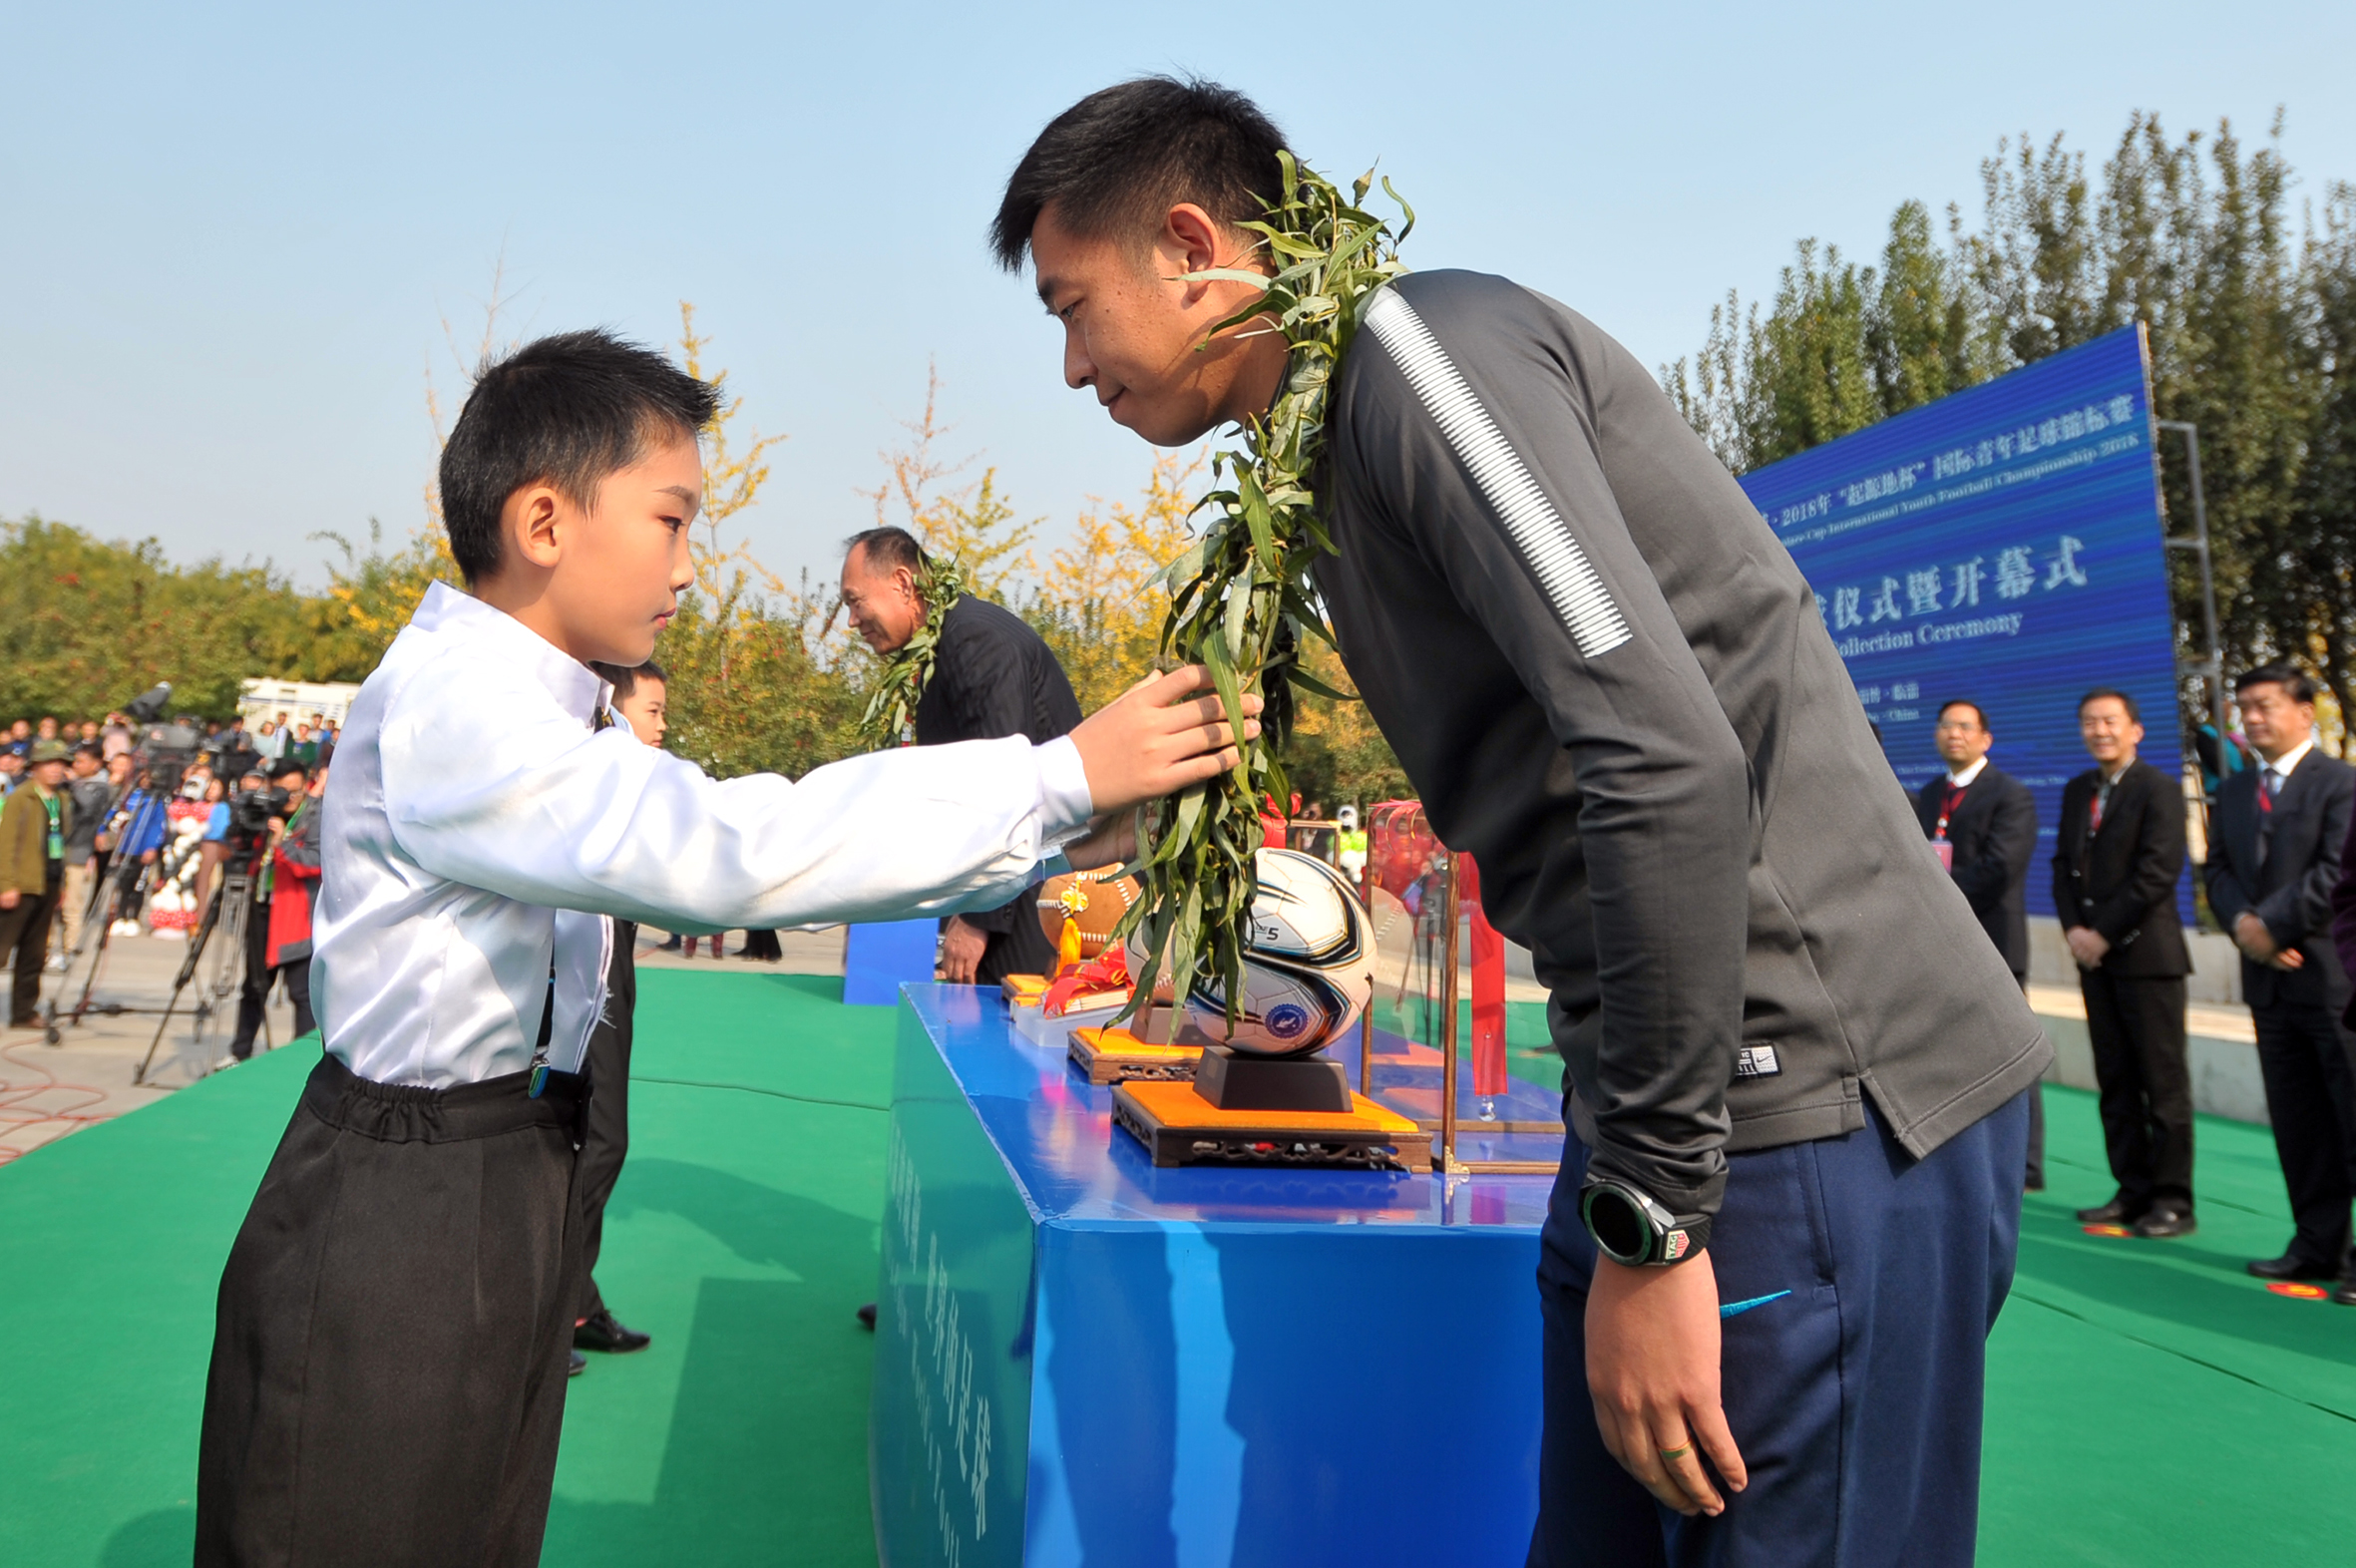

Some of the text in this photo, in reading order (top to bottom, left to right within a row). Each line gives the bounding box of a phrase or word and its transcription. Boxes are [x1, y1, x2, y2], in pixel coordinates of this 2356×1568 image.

[1828, 506, 1898, 534] International
[1902, 494, 1936, 513] Youth
[1938, 477, 1994, 502] Football
[1996, 446, 2098, 485] Championship
[2100, 432, 2140, 457] 2018
[1835, 611, 2024, 657] ollection Ceremony
[1266, 927, 1280, 941] 5
[1667, 1235, 1678, 1257] TAG
